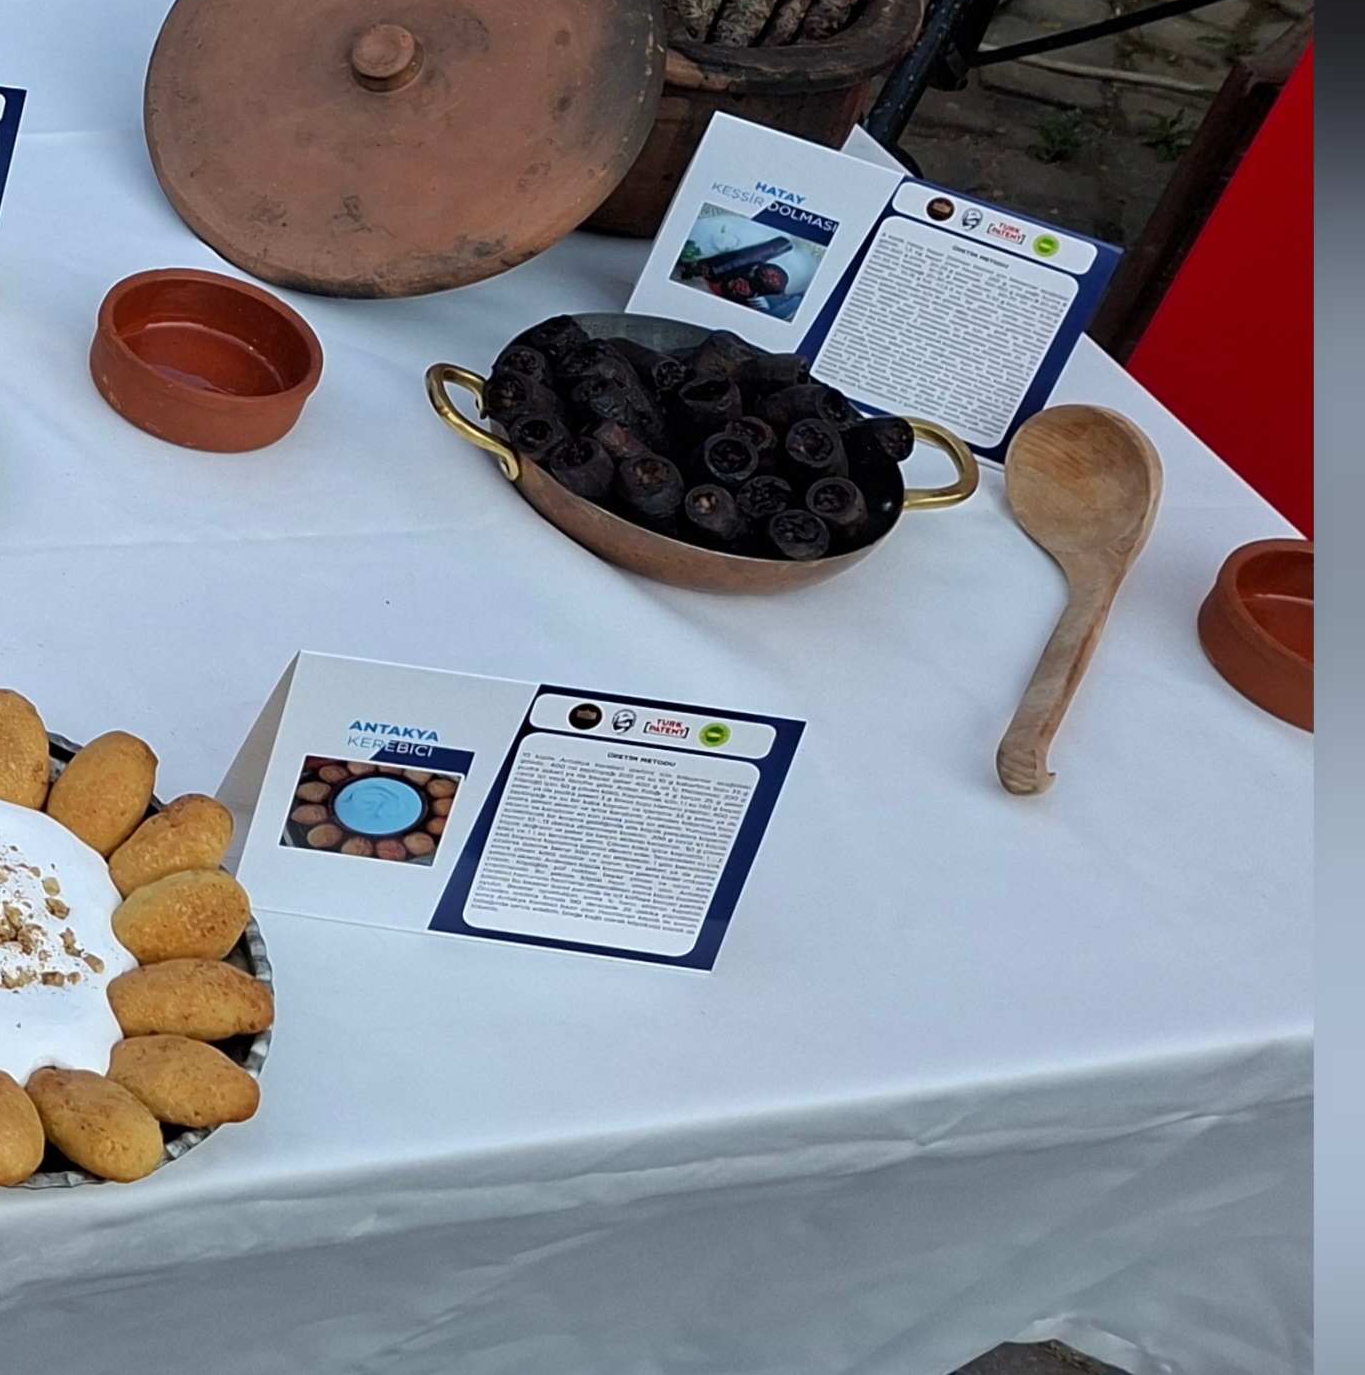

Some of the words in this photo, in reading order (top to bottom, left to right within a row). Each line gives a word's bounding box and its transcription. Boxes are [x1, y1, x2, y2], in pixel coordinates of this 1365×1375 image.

[755, 182, 806, 205] HATAY
[767, 201, 837, 233] DOLMASI
[349, 720, 439, 742] ANTAKYA
